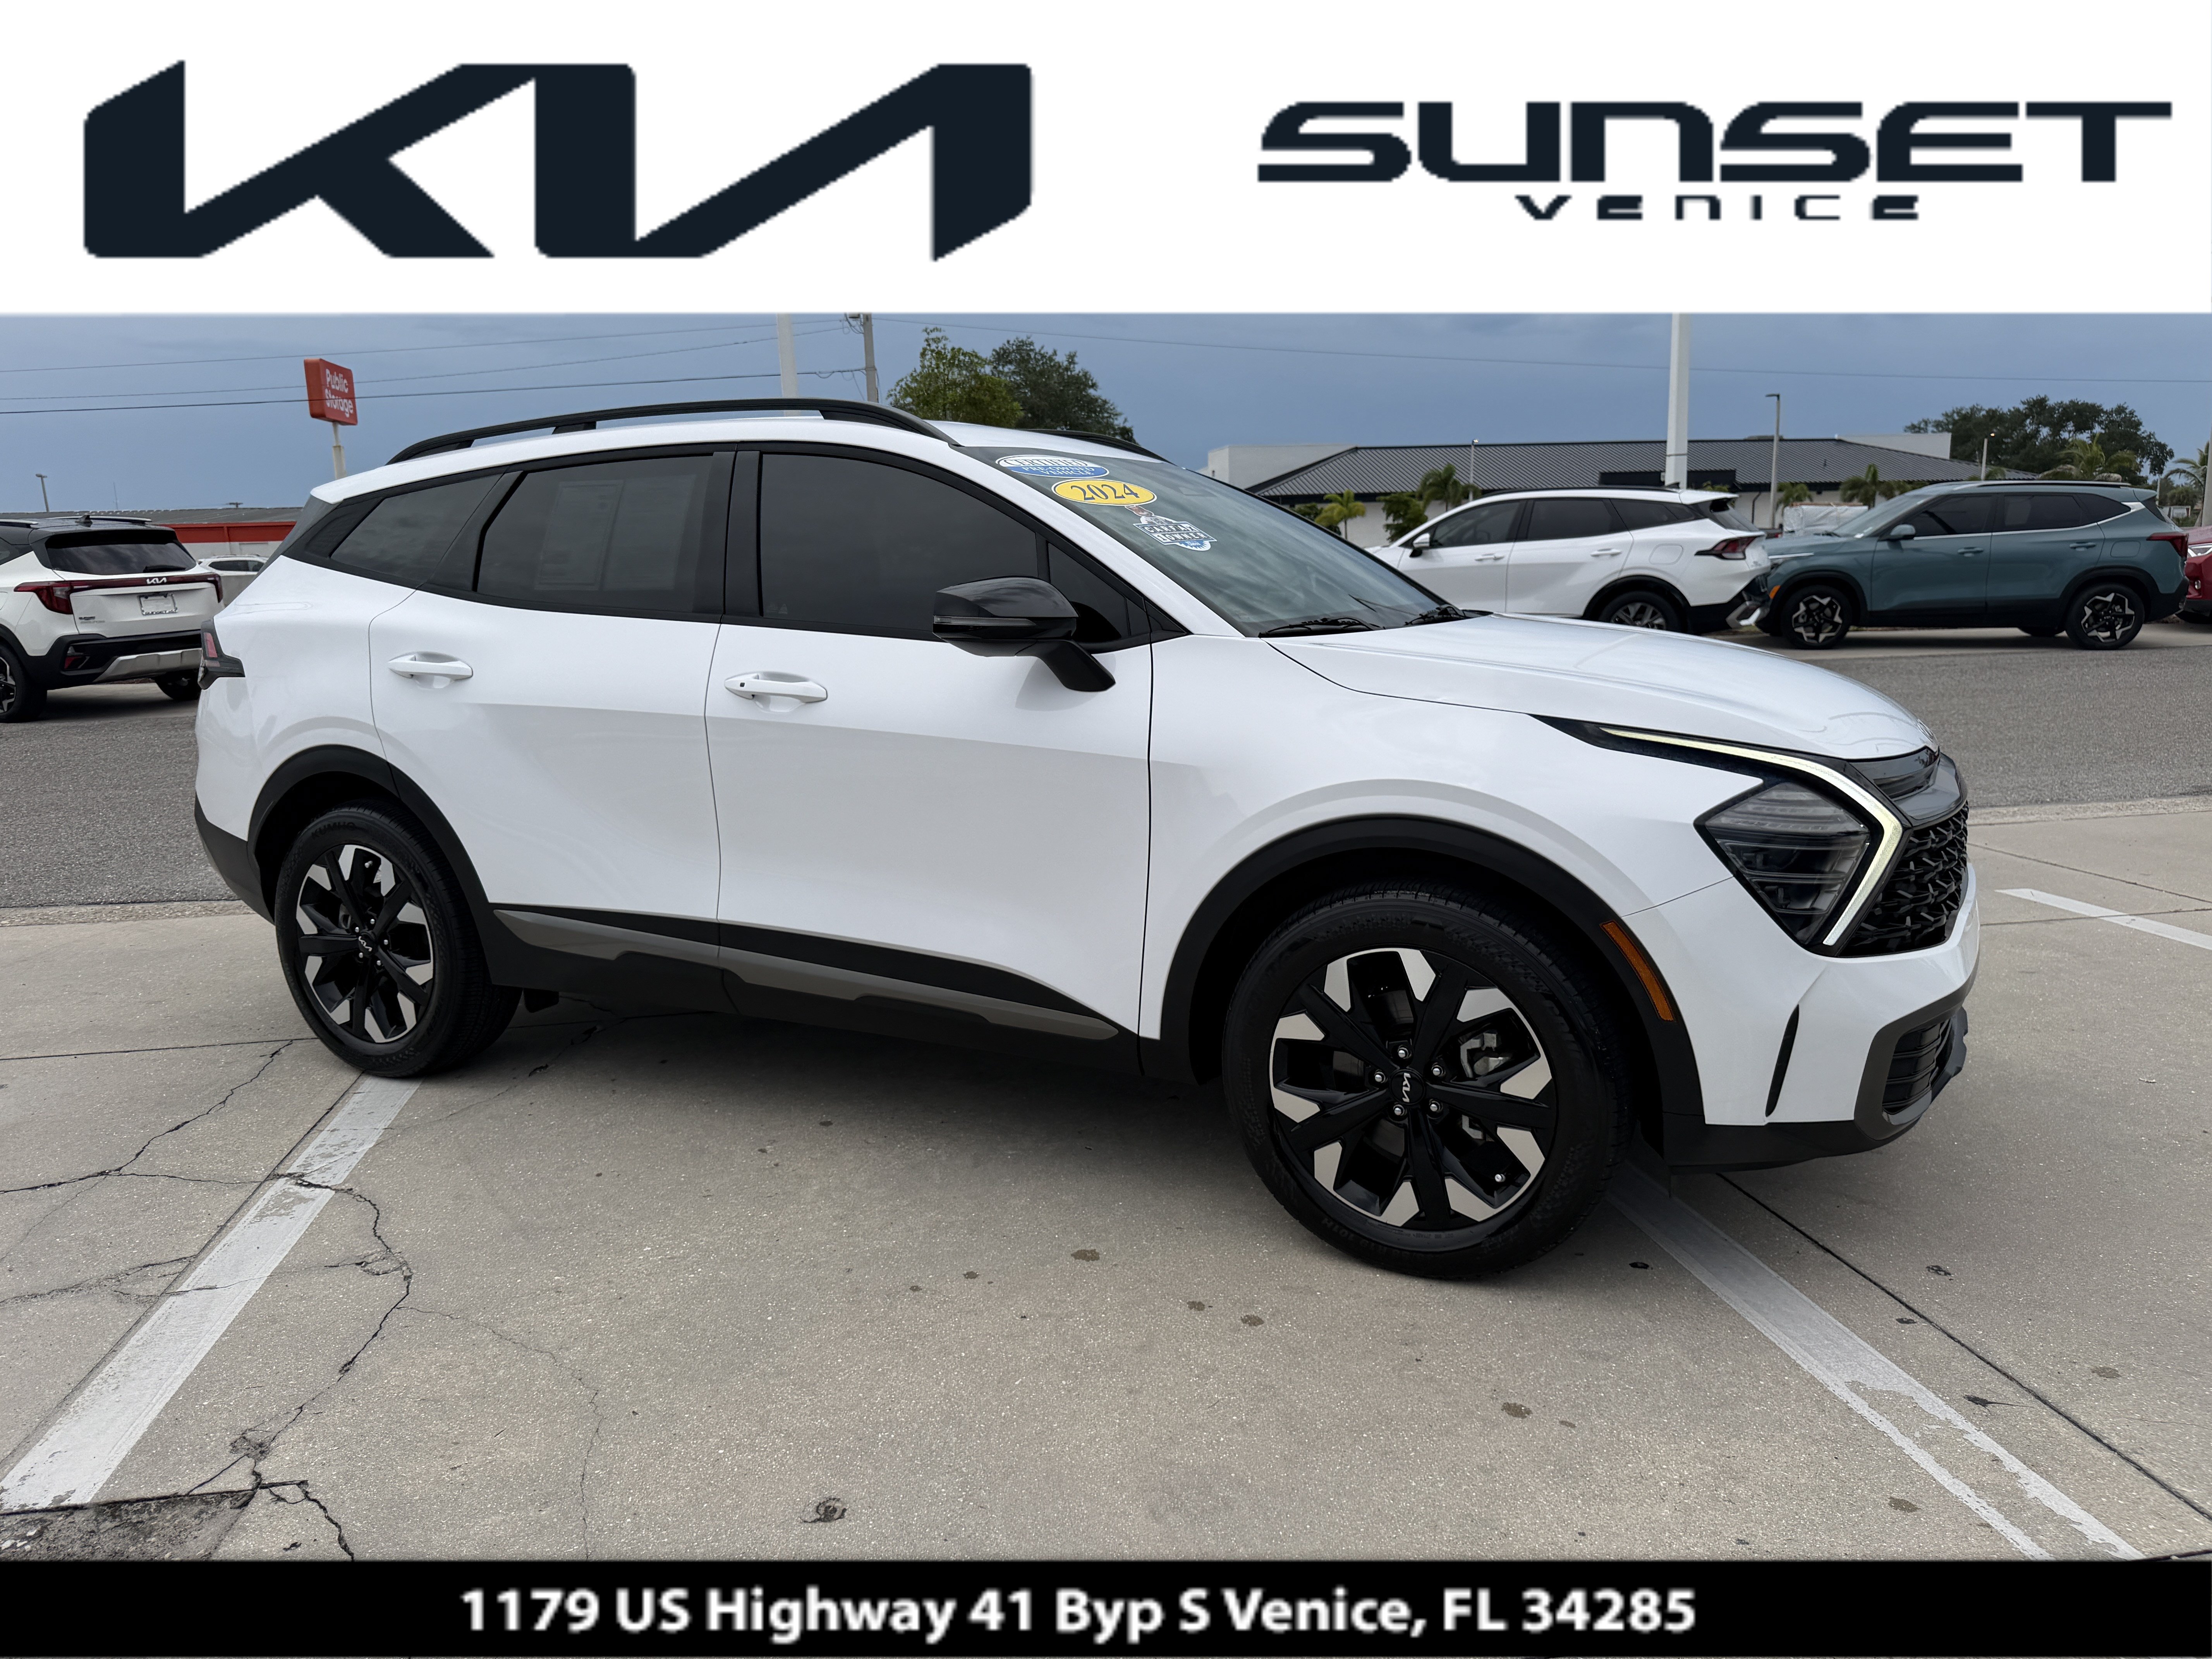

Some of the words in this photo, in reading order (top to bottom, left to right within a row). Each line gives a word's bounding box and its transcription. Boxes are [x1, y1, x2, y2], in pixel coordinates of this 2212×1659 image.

[326, 369, 348, 393] Public
[325, 388, 353, 417] Storage
[1071, 484, 1140, 500] 2024
[1144, 524, 1199, 533] CARFAX
[1402, 1072, 1411, 1103] KIA
